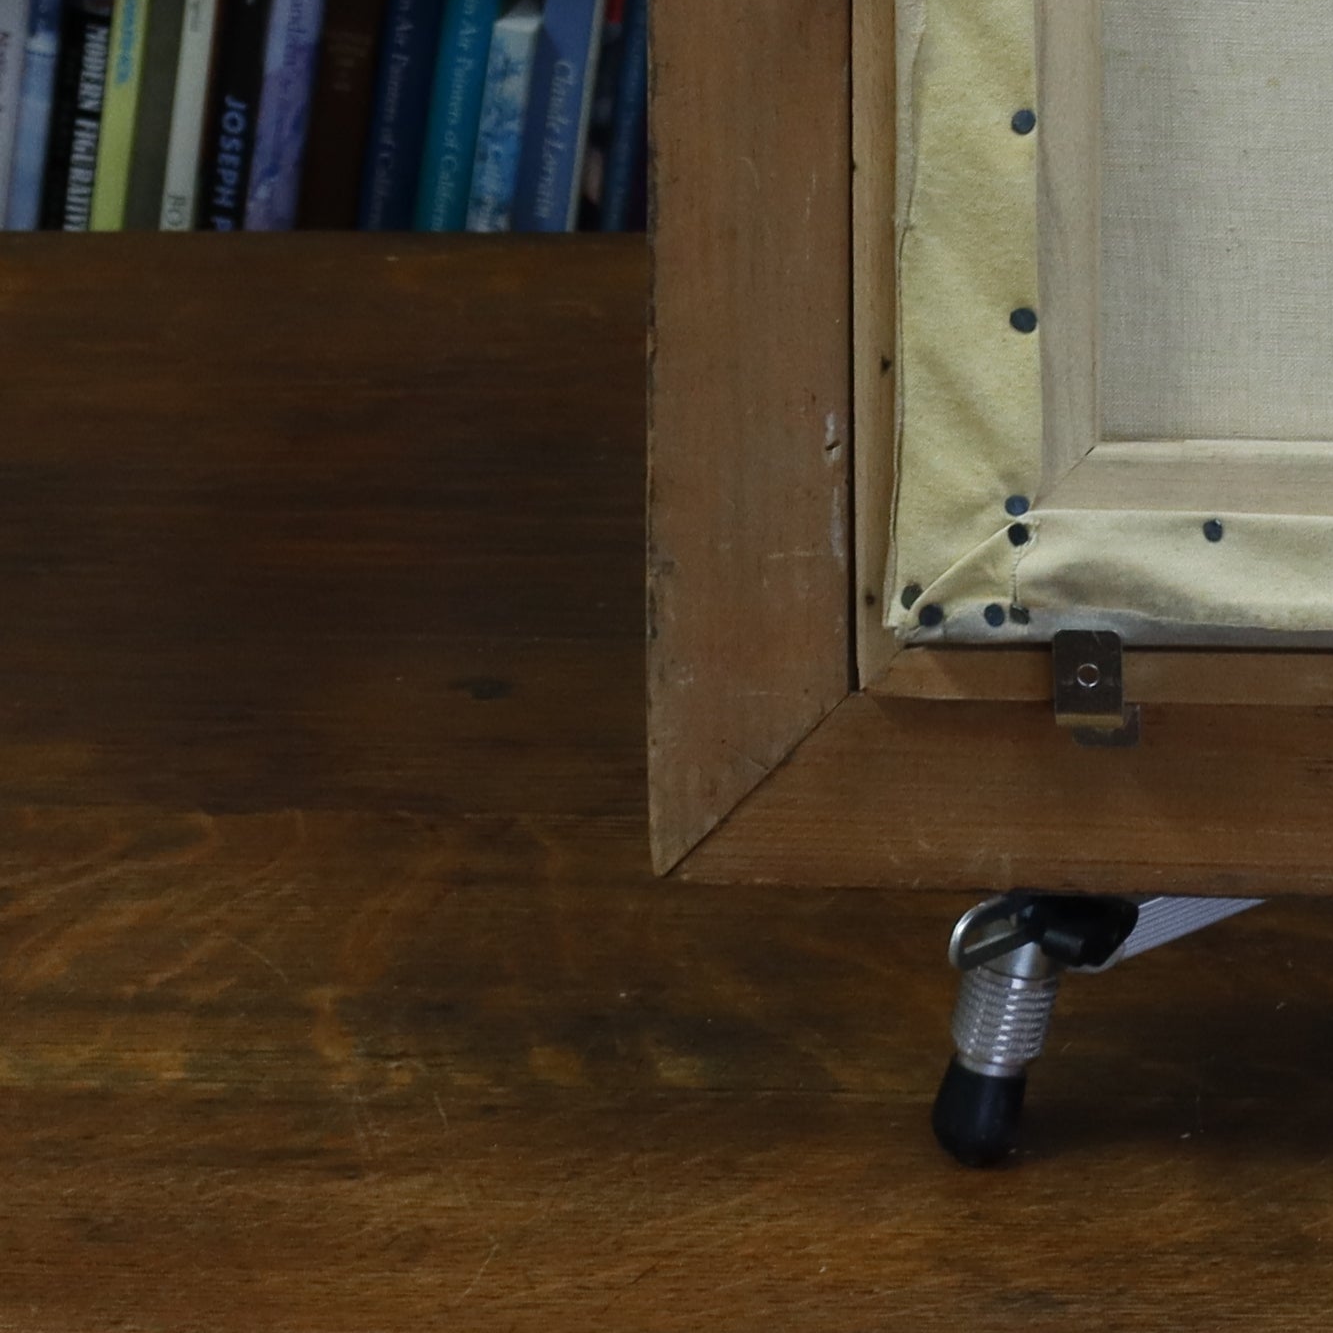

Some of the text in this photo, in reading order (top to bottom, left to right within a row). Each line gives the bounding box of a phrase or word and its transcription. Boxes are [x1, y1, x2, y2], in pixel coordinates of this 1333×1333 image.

[393, 17, 415, 46] Air
[456, 21, 476, 50] Air
[76, 23, 111, 112] MODERN
[447, 56, 474, 125] Painters
[544, 61, 575, 129] Claude
[214, 95, 248, 206] JOSEPH
